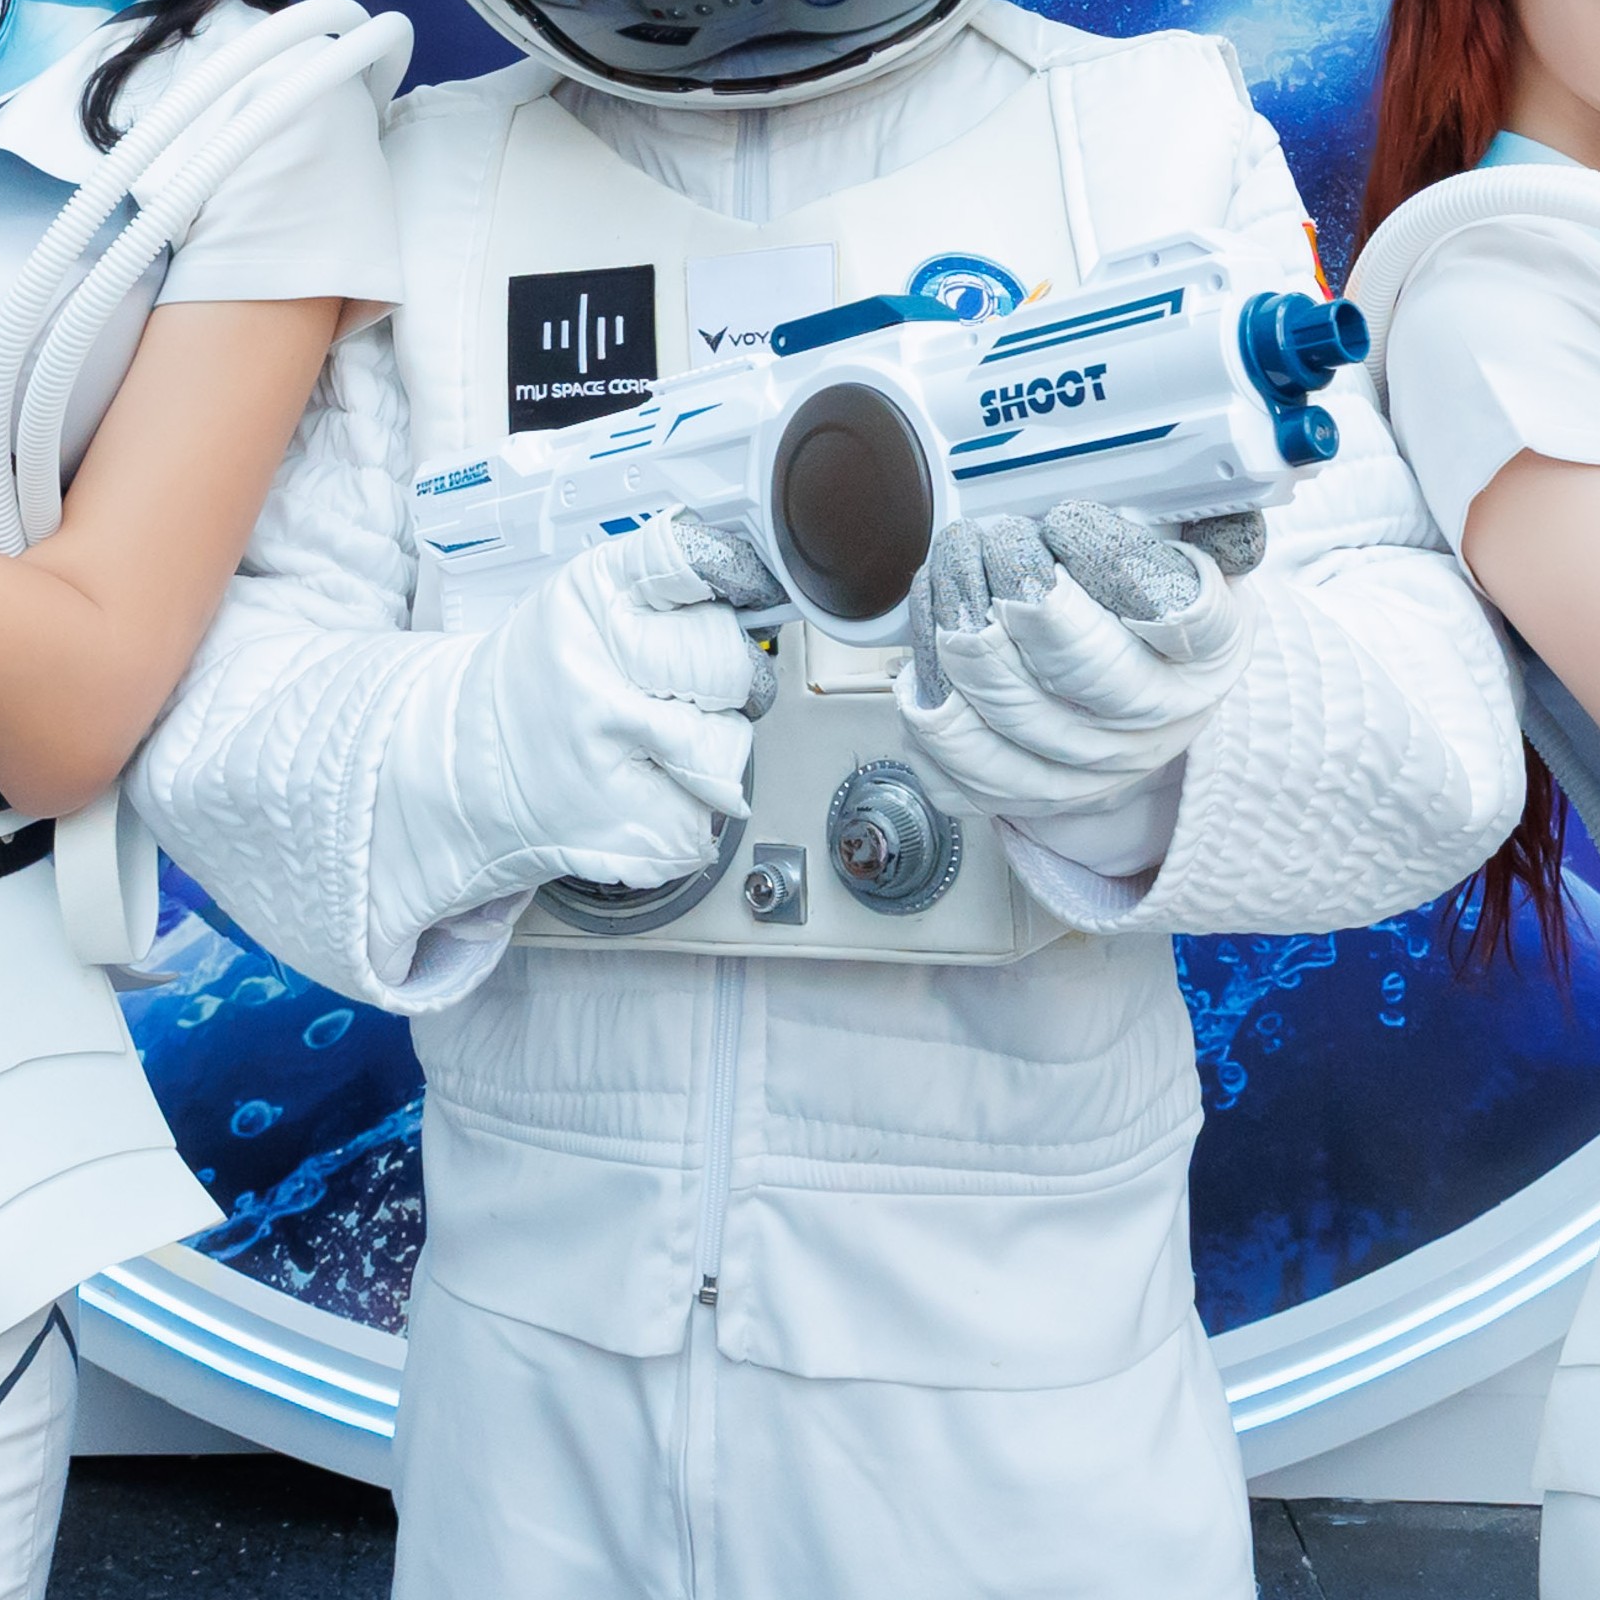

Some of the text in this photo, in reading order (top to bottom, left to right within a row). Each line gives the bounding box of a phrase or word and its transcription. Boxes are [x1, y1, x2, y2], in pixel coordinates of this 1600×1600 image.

[728, 331, 772, 347] VOY
[551, 380, 606, 398] SPACE
[980, 363, 1107, 427] SHOOT
